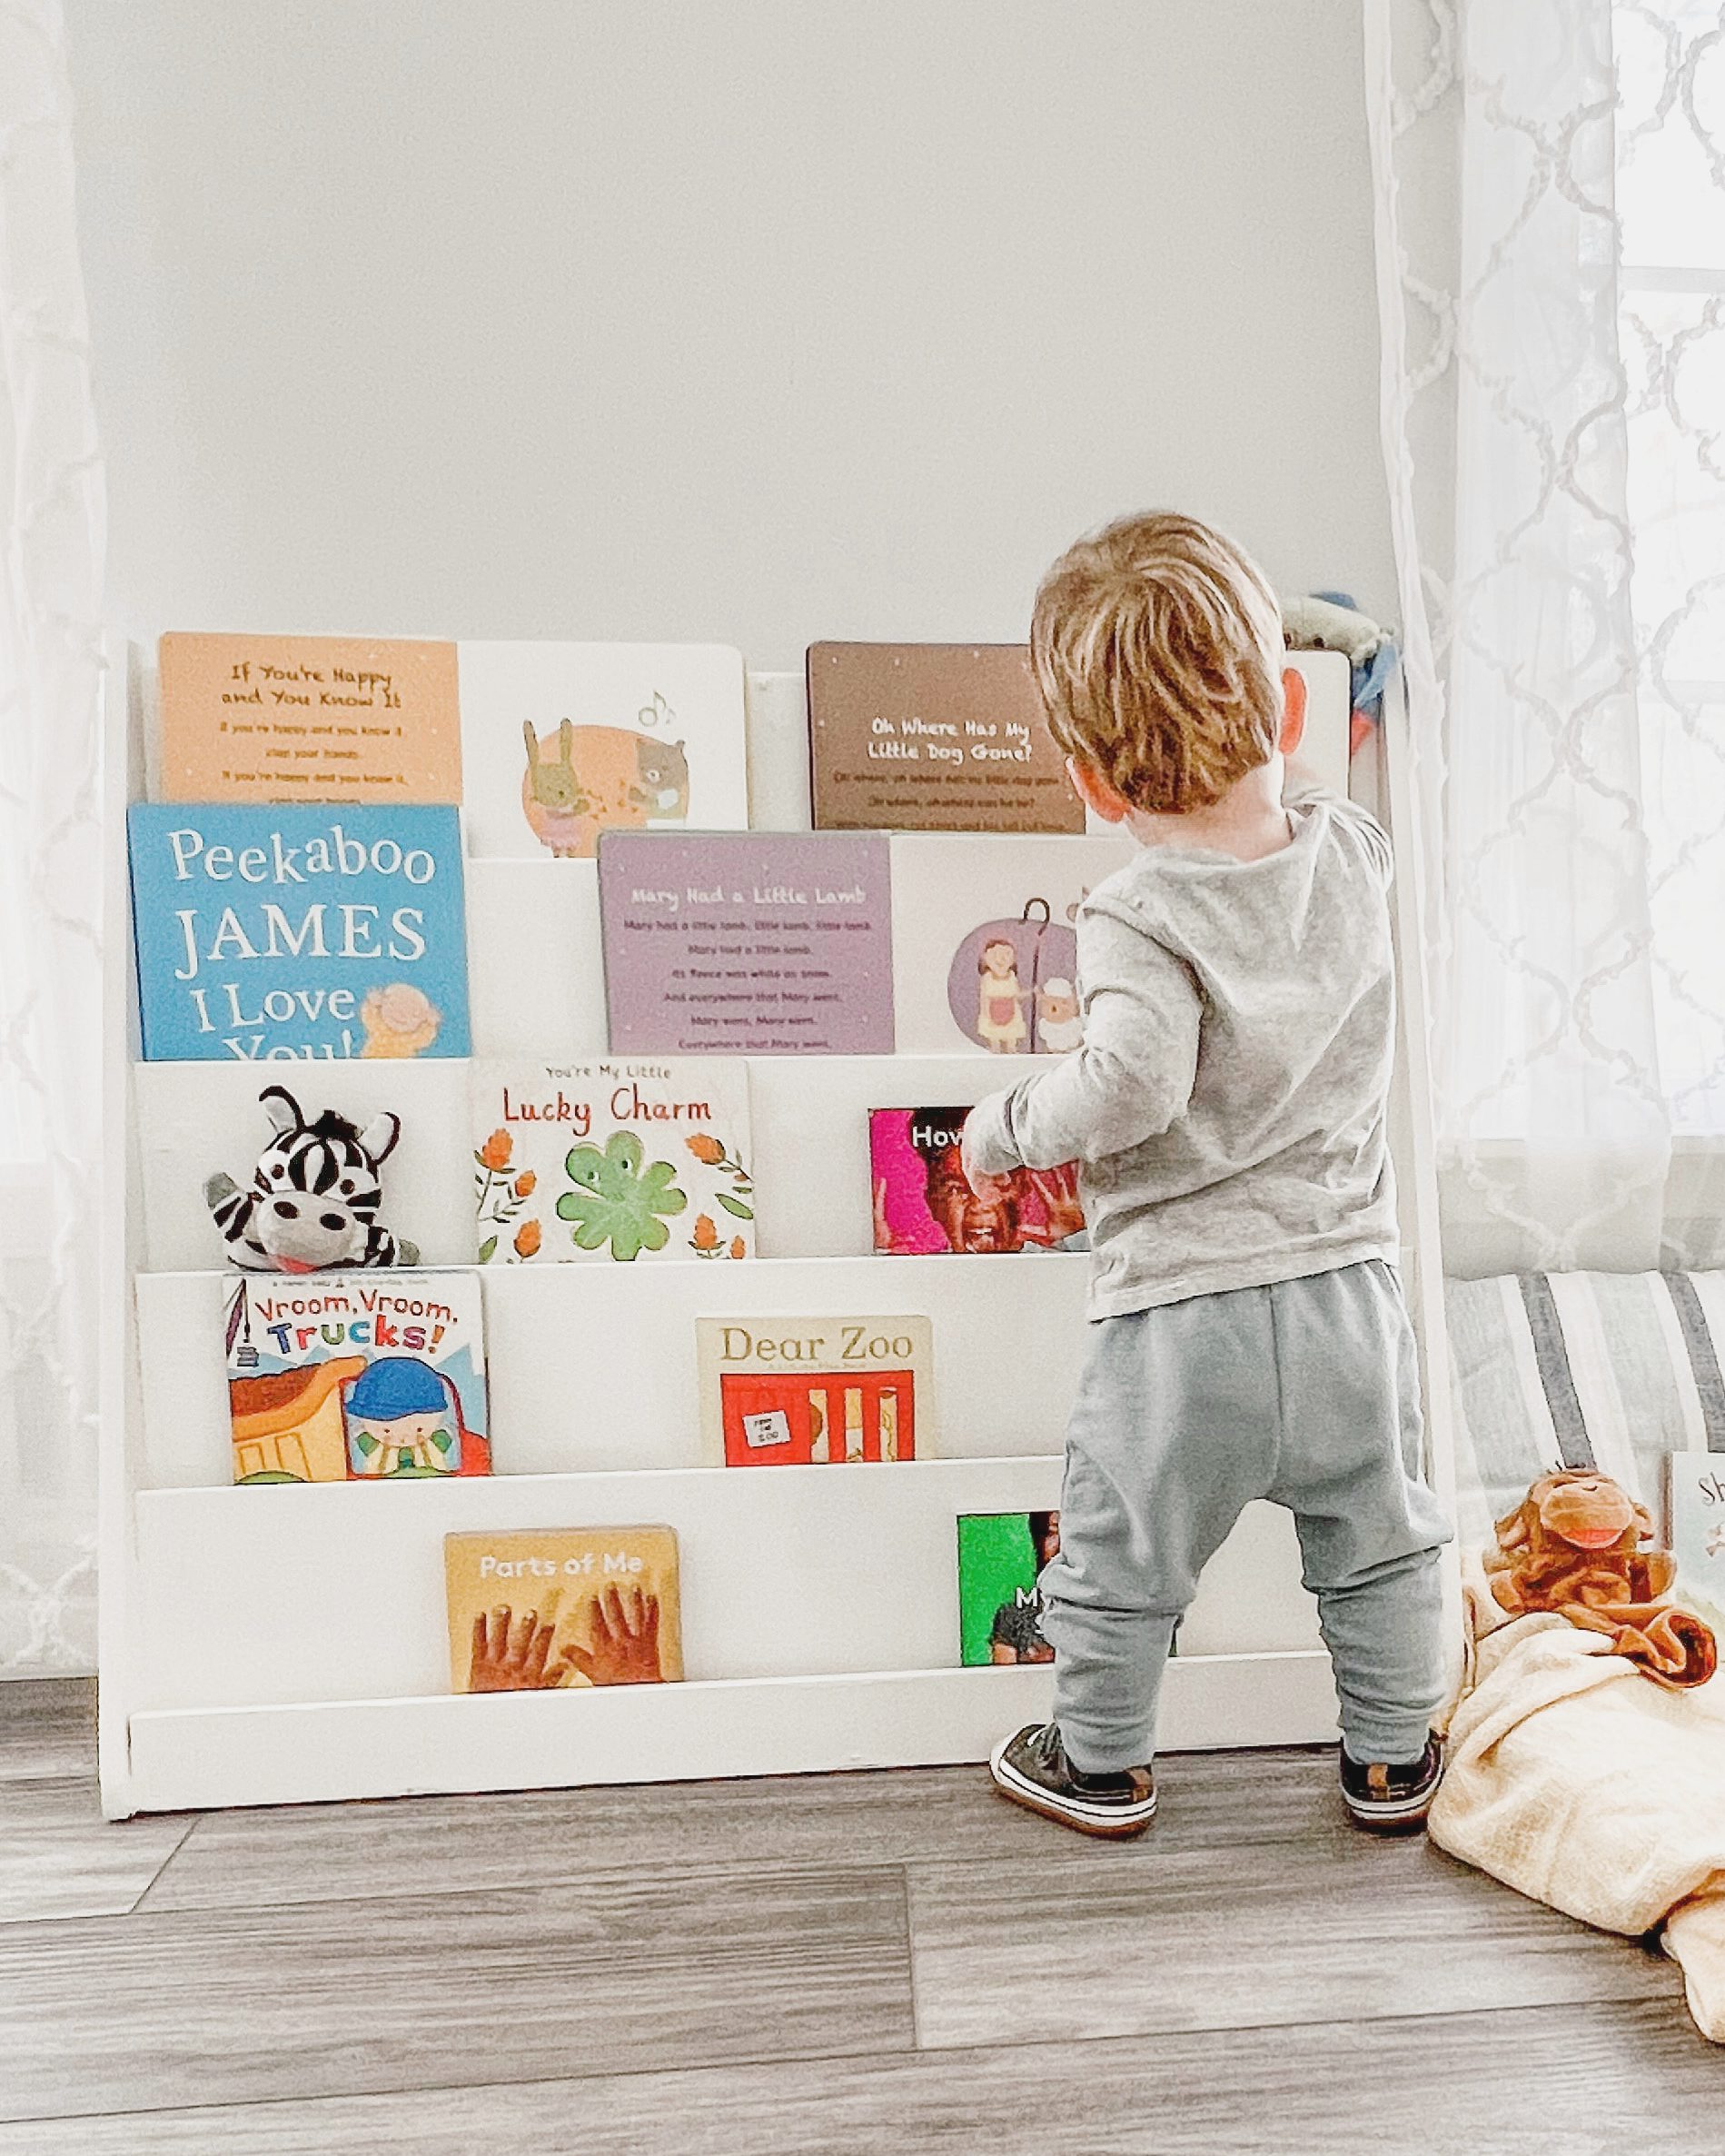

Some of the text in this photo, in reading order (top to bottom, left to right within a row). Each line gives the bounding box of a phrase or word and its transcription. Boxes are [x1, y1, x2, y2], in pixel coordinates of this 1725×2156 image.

[232, 661, 392, 693] If You're Happy
[222, 688, 402, 710] and You Know It
[872, 717, 1032, 745] Oh Where Has My
[868, 741, 1033, 766] Little Dog Gone?
[167, 824, 436, 884] Peekaboo
[631, 884, 867, 912] Mary Had a Little Lamb
[174, 904, 428, 980] JAMES
[189, 983, 355, 1033] I Love
[546, 1064, 672, 1081] You're My Little
[503, 1082, 712, 1138] Lucky Charm
[255, 1288, 459, 1324] Vroom, Vroom,
[267, 1314, 446, 1355] Trucks!
[719, 1326, 914, 1362] Dear Zoo
[480, 1551, 644, 1580] Parts of Me
